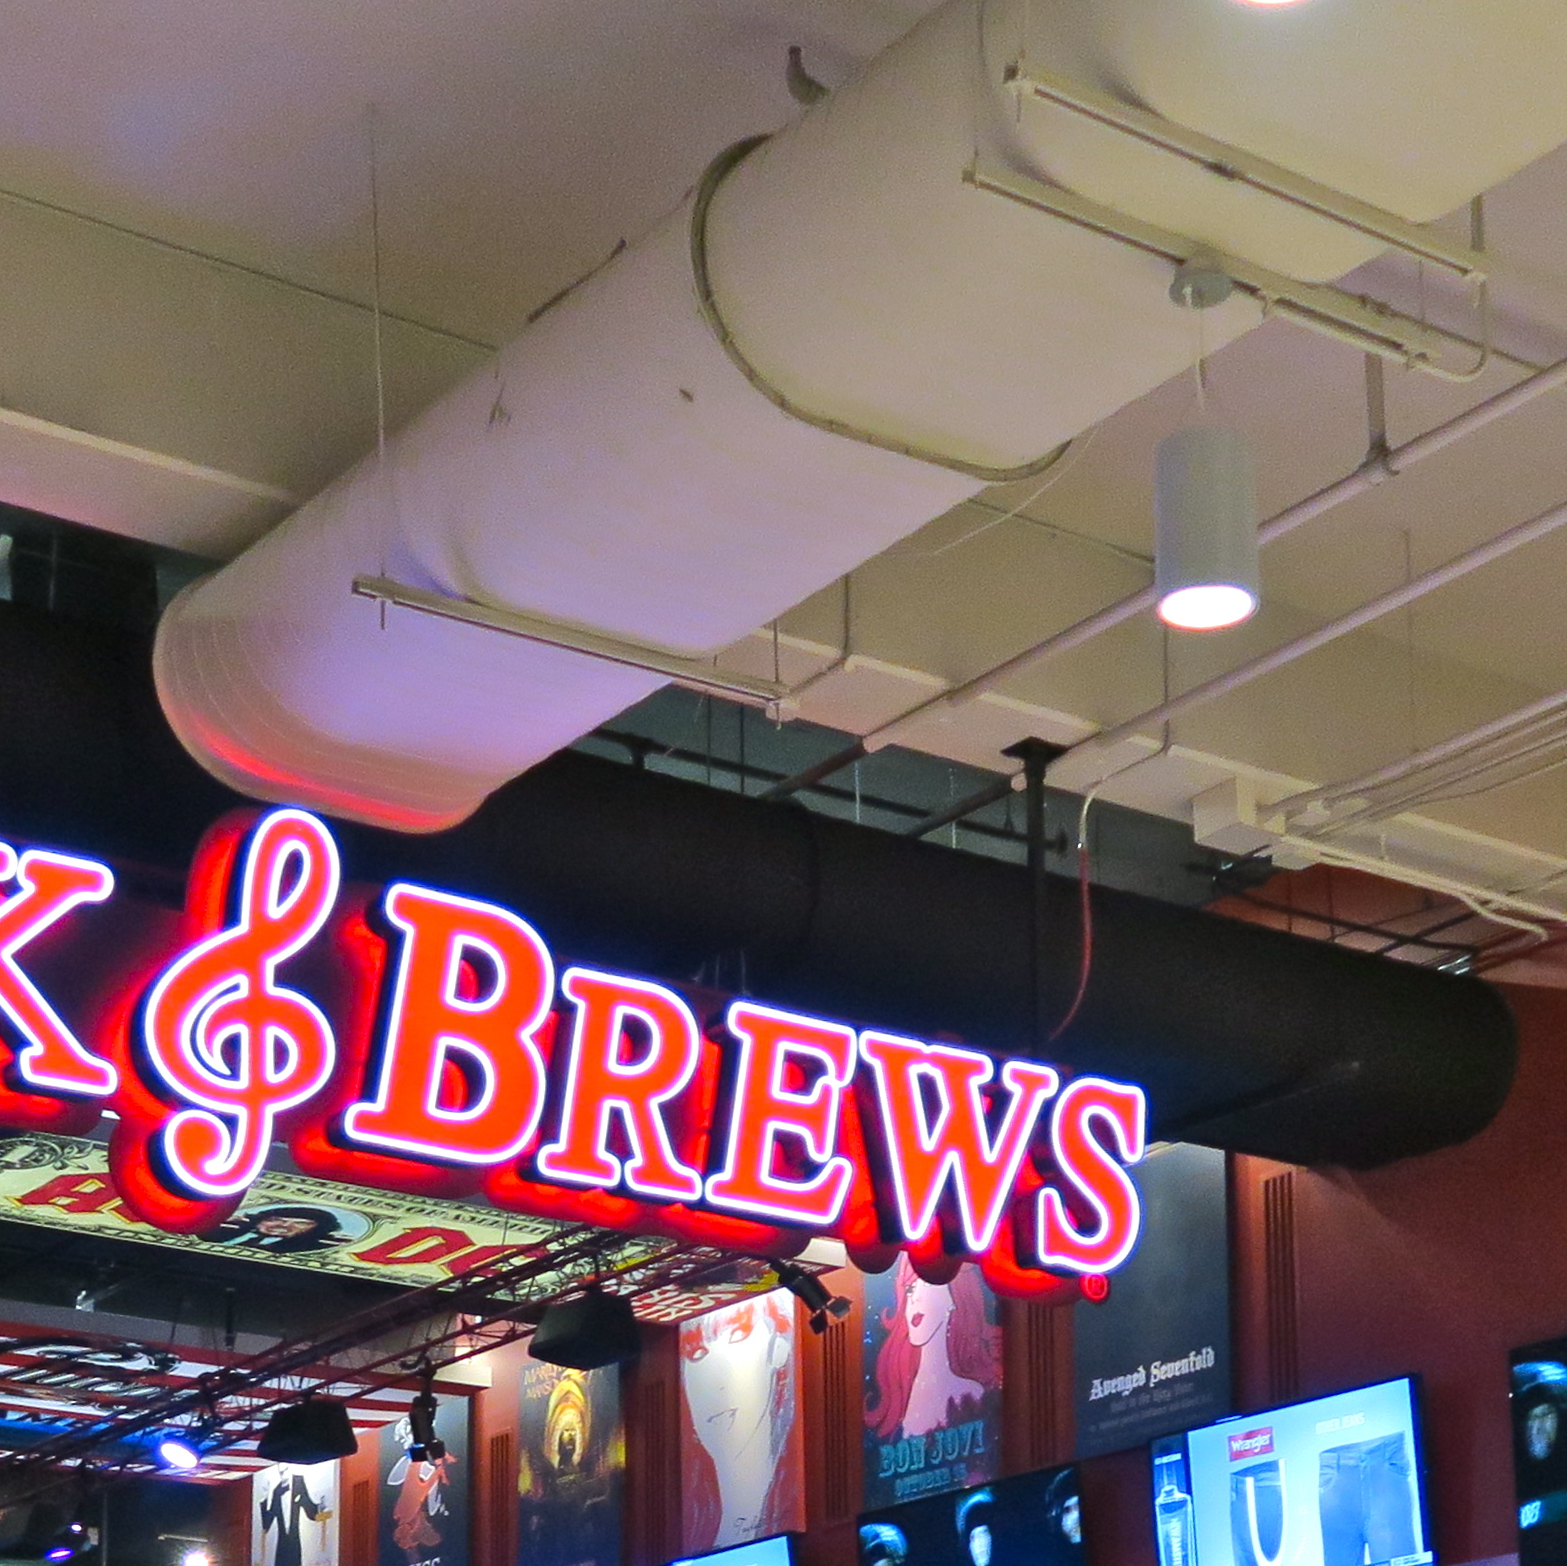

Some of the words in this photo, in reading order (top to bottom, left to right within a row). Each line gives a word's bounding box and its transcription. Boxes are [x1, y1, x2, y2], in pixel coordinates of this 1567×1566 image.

[341, 881, 1150, 1277] BREWS
[1089, 1364, 1147, 1402] Avenged
[1149, 1345, 1216, 1388] Sevenfold
[930, 1419, 985, 1465] JOVI
[1230, 1431, 1272, 1453] Wrangler
